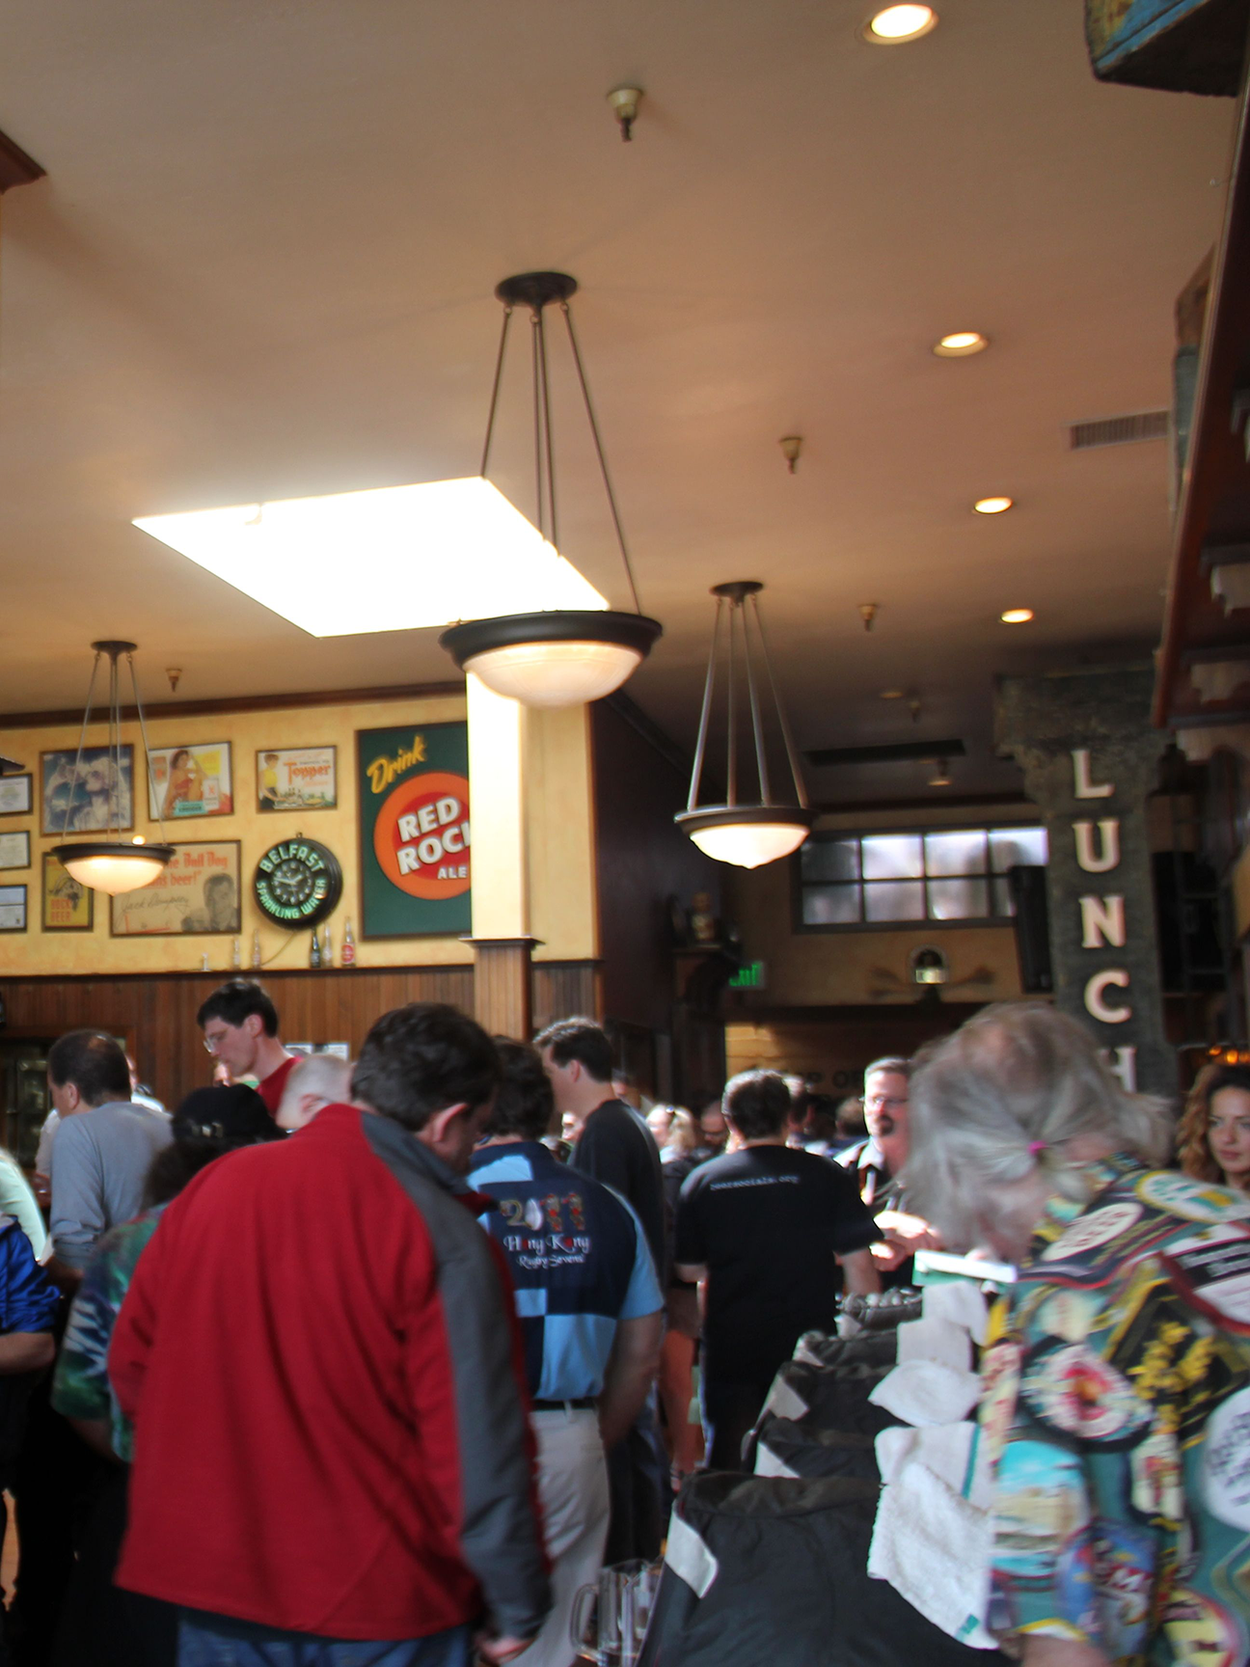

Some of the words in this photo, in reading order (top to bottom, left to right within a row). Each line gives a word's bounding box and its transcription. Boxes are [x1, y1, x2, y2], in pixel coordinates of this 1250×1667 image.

[283, 762, 332, 785] Topper
[366, 735, 425, 794] Drink
[398, 797, 460, 842] RED
[183, 851, 204, 867] Bull
[207, 851, 228, 869] Dog
[259, 844, 324, 873] BELFAST
[437, 866, 468, 880] ALE
[256, 881, 300, 919] SPARKLING
[51, 911, 70, 922] BEER
[503, 1235, 546, 1256] Hong
[546, 1233, 590, 1254] Kong
[516, 1254, 549, 1269] Rugby
